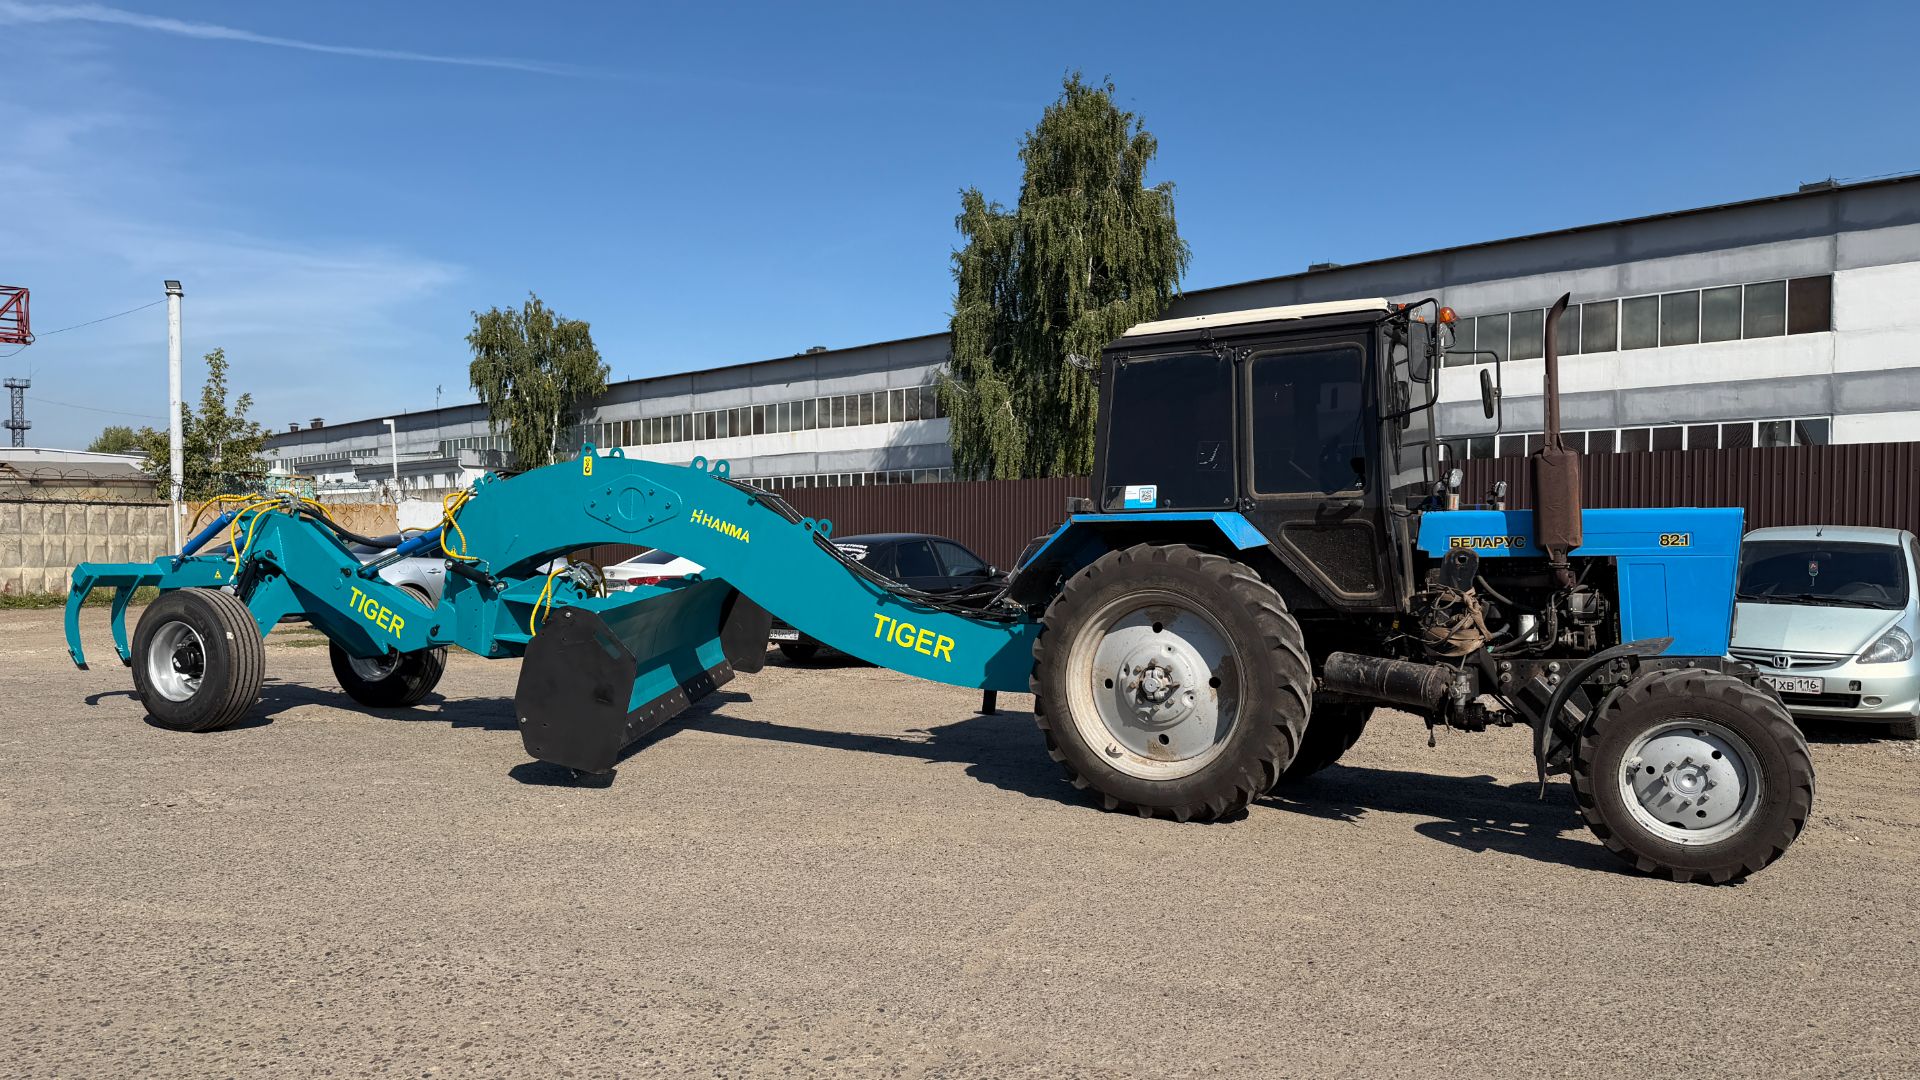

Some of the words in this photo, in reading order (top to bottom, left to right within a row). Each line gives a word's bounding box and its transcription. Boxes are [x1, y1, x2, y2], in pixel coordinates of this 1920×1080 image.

[1449, 536, 1527, 549] БЕЛАРУС
[1659, 533, 1690, 547] 82.1
[349, 585, 405, 640] TIGER
[873, 612, 955, 663] TIGER
